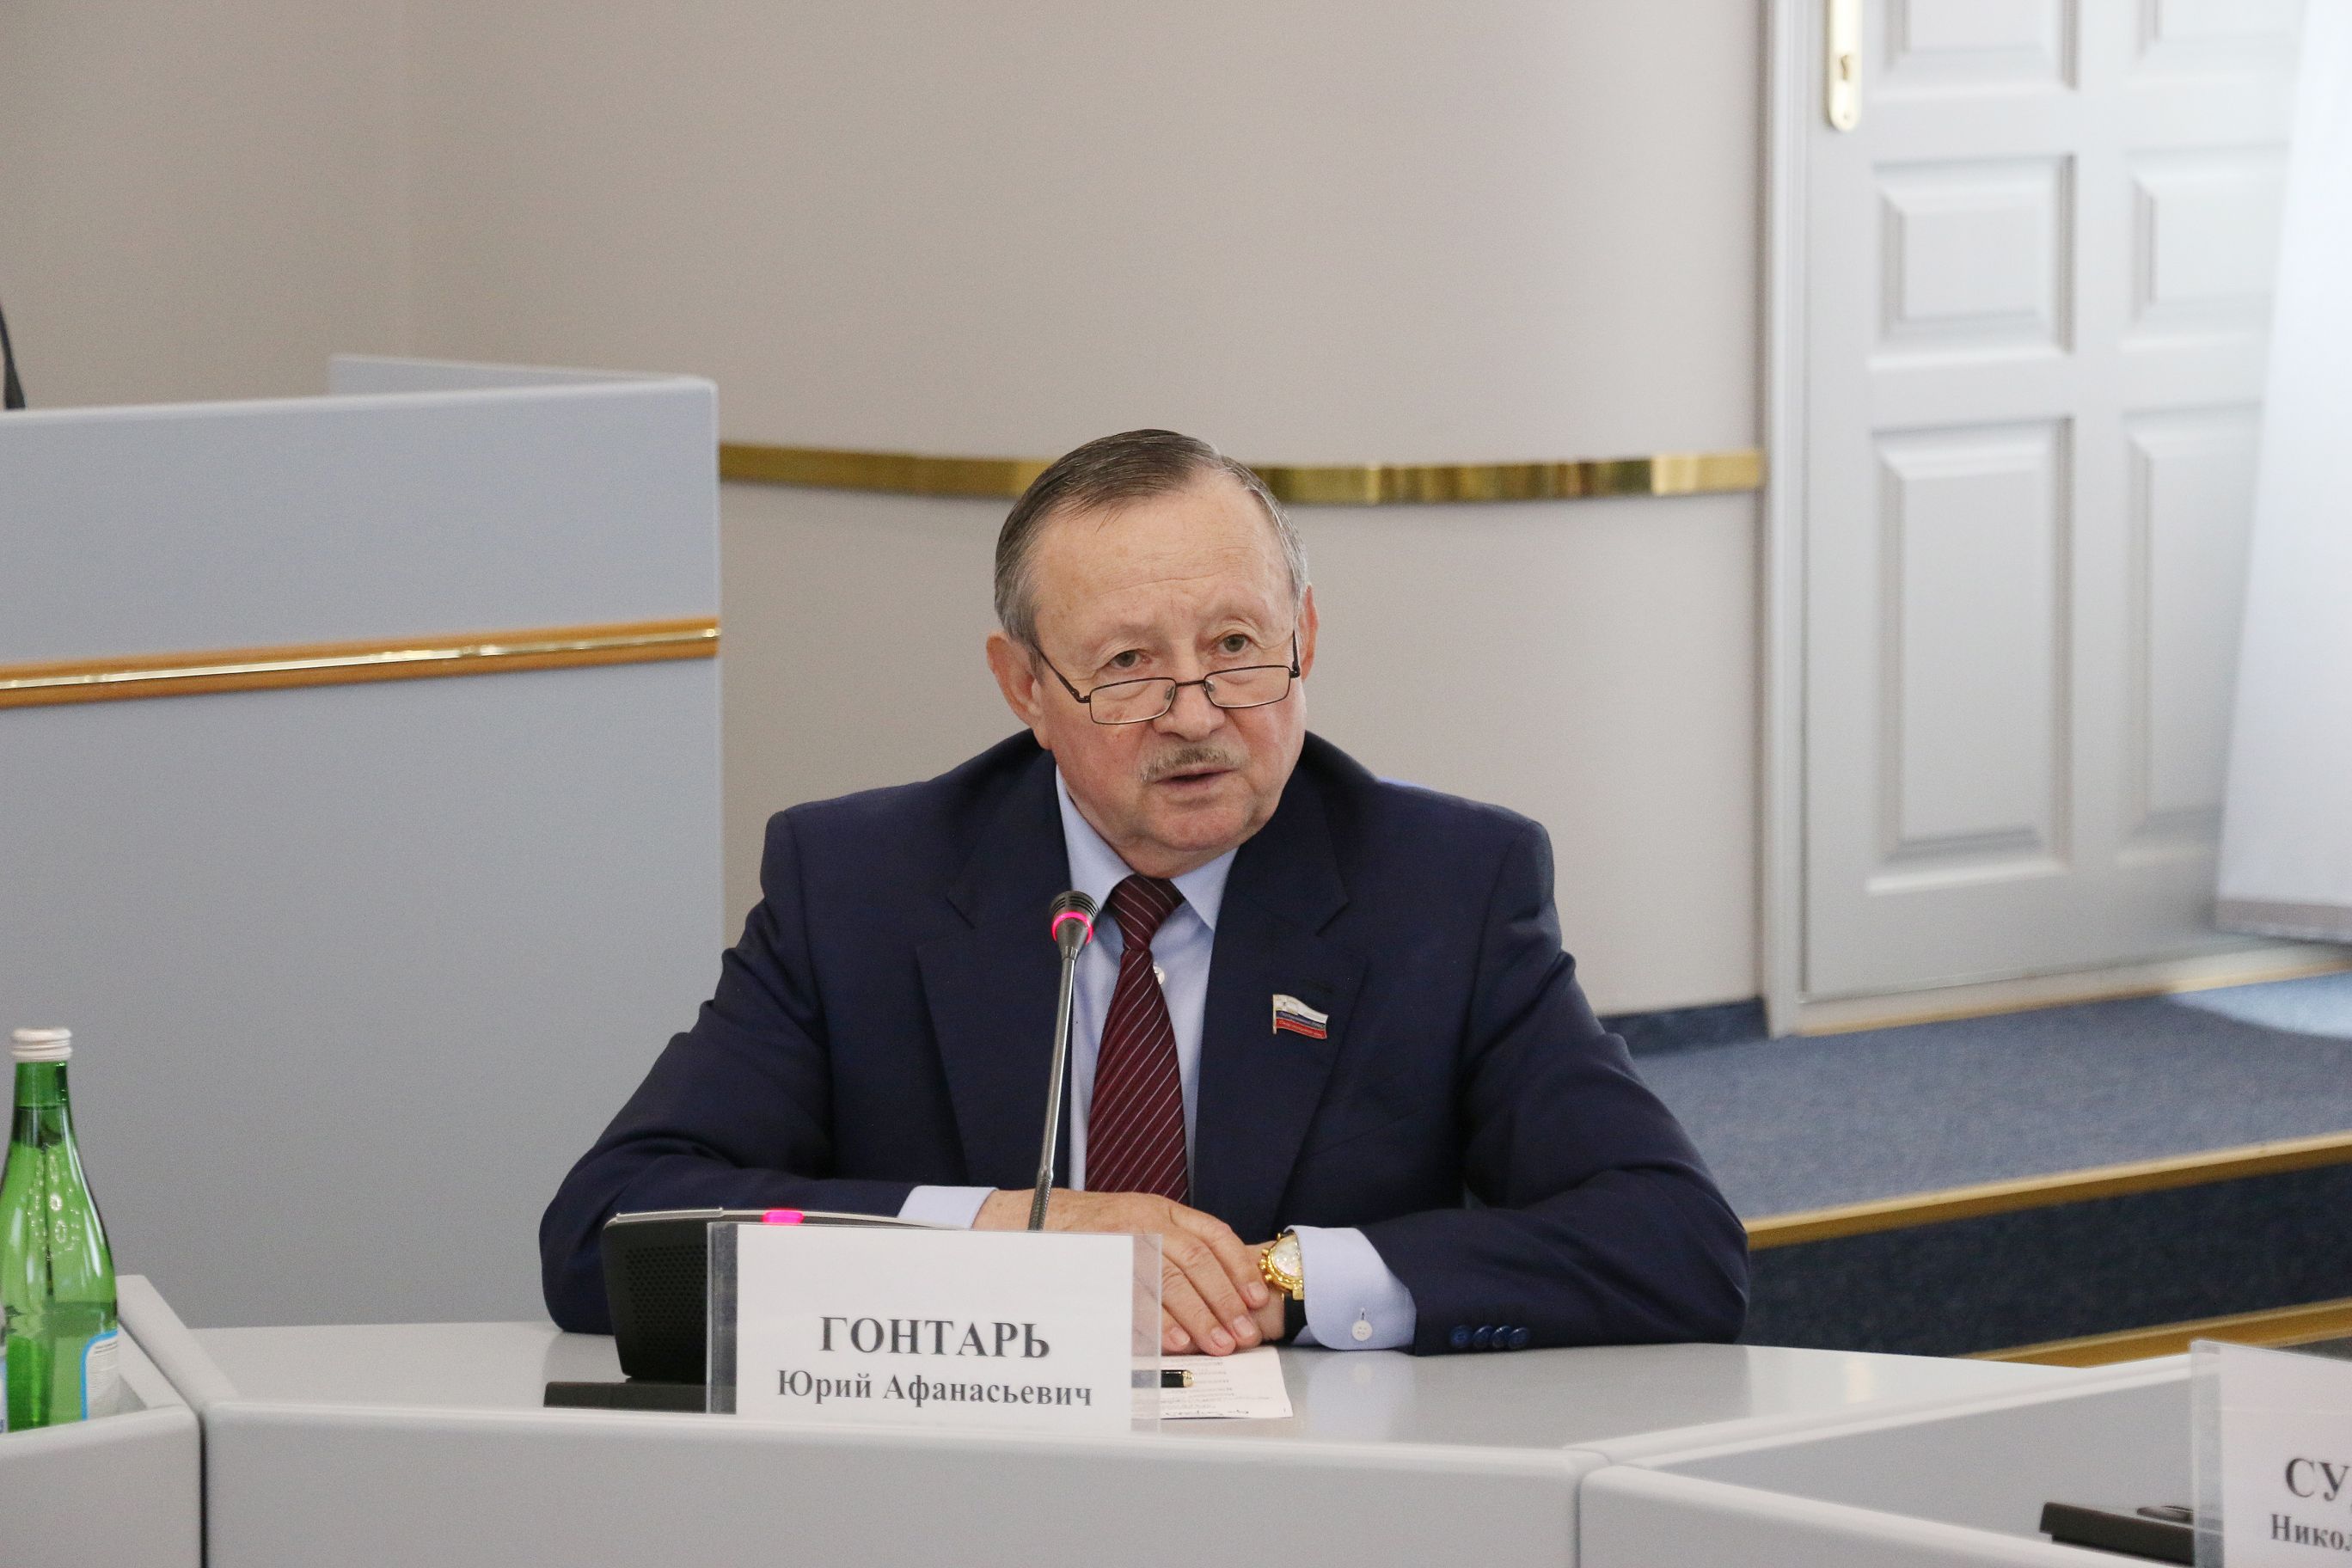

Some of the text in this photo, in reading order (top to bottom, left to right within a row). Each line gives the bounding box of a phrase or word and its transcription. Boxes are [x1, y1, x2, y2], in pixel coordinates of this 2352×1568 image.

[819, 1316, 1050, 1358] ГОНТАРЬ
[777, 1369, 1092, 1408] Юрий Афанасьевич
[2285, 1457, 2352, 1502] СУ
